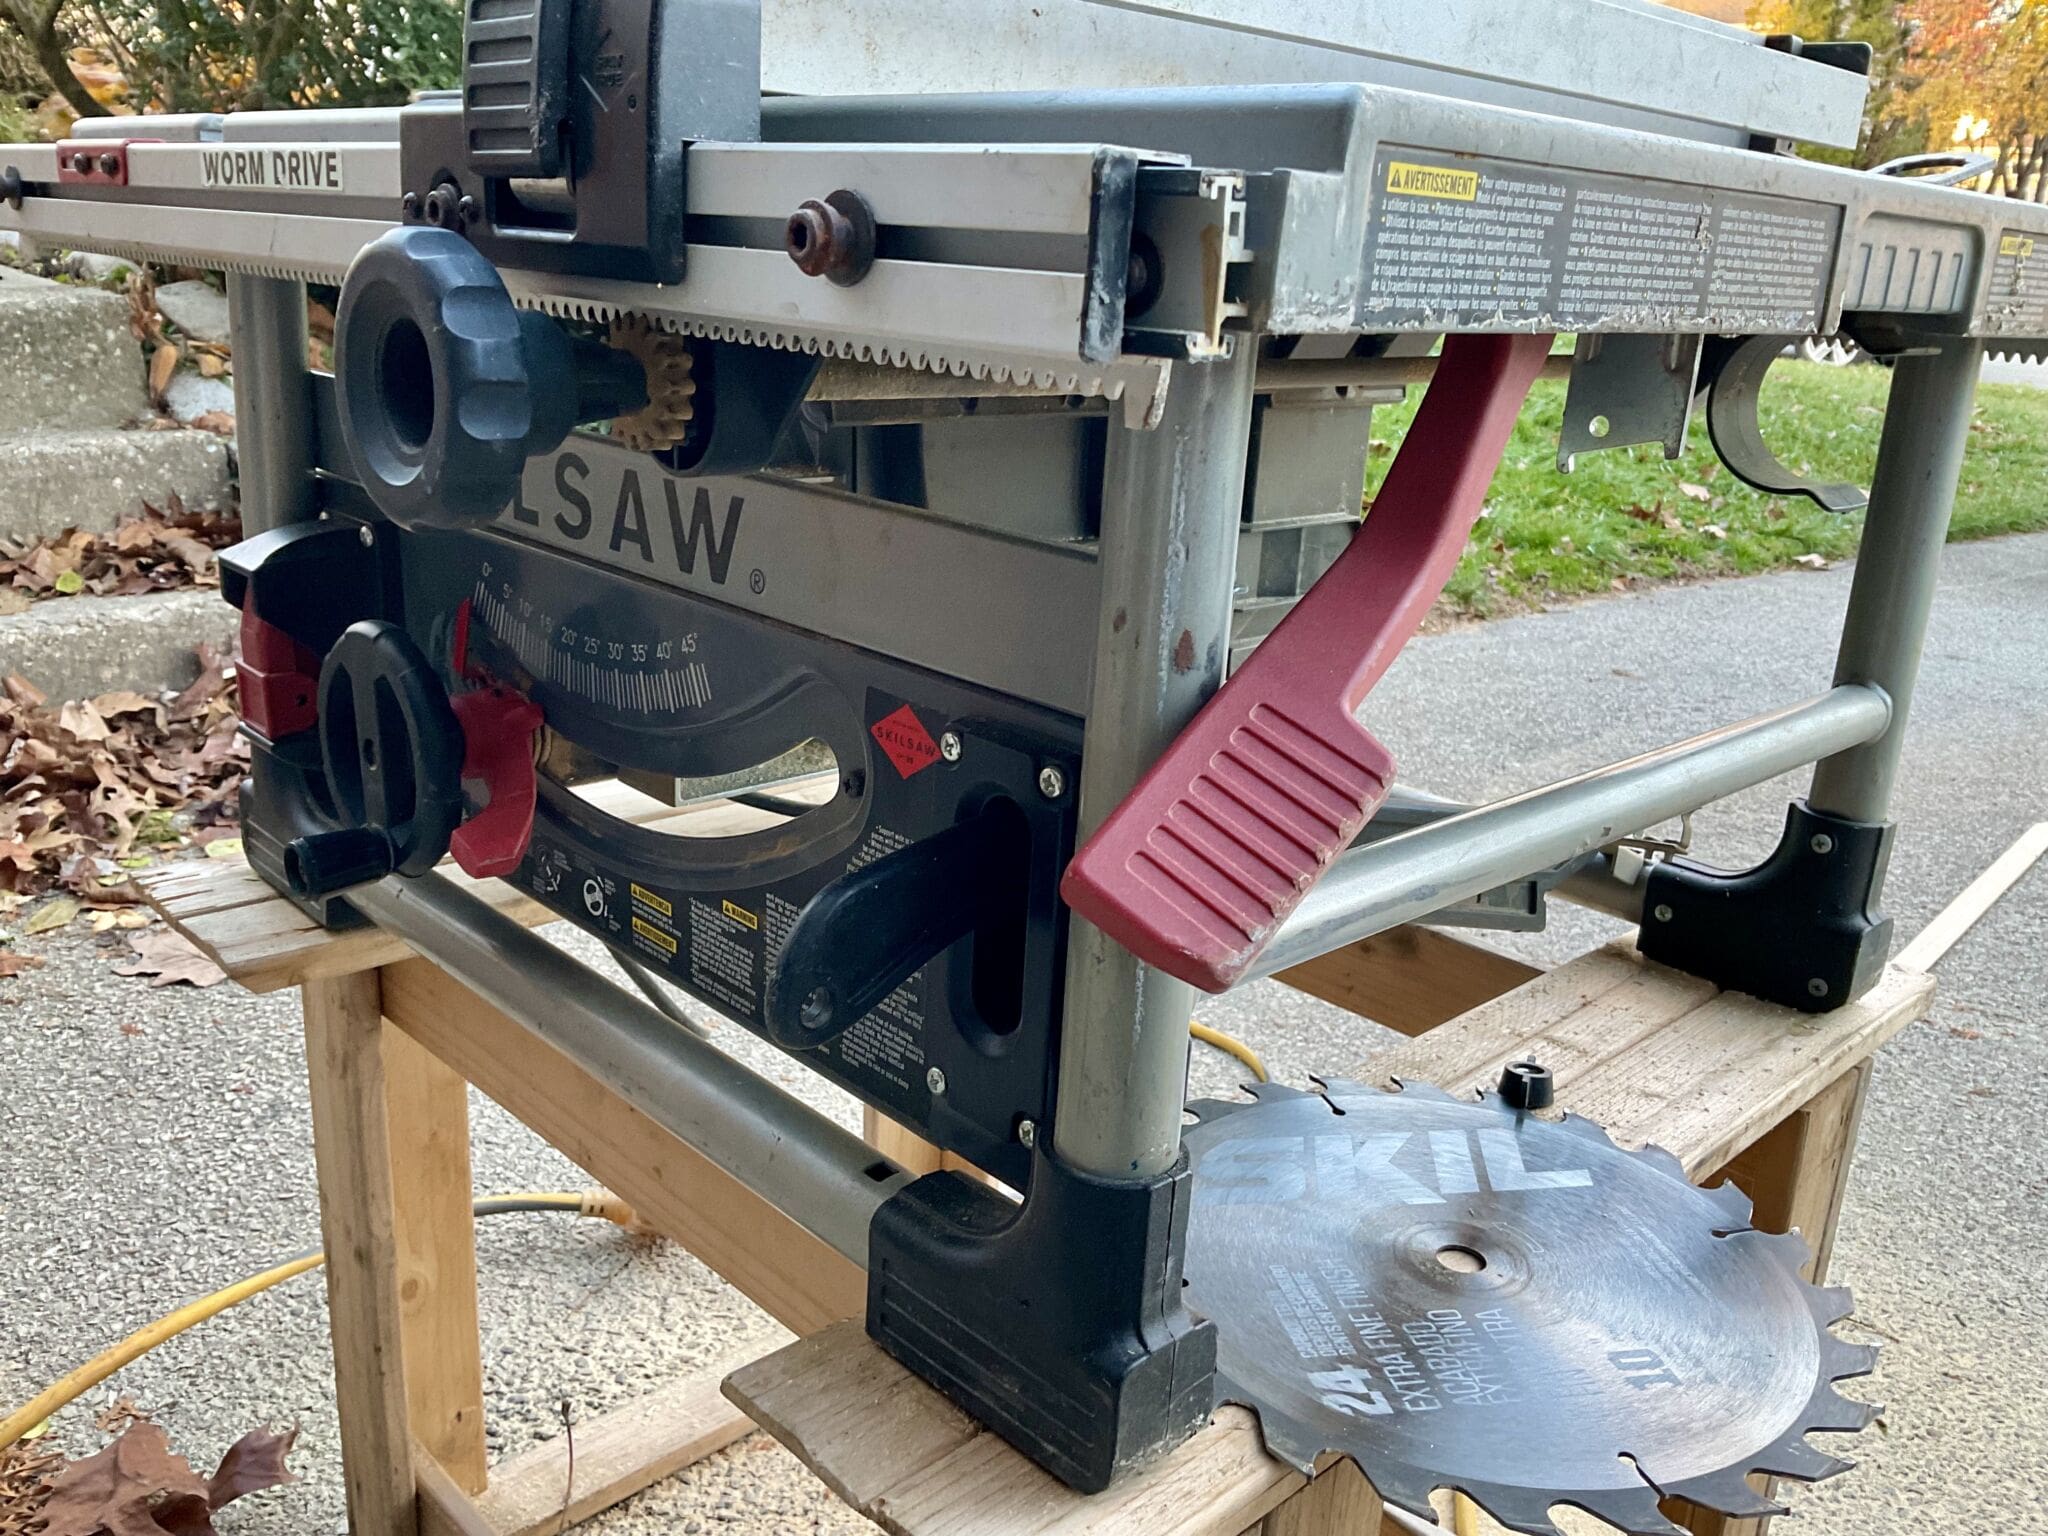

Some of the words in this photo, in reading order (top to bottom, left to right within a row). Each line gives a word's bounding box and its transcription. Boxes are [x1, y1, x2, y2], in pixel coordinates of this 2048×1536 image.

[202, 151, 265, 185] WORM
[273, 151, 339, 187] DRIVE
[1402, 168, 1473, 197] AVERTISSEMENT
[877, 726, 936, 757] SKILSAW
[731, 905, 756, 927] WARNING
[1196, 1128, 1594, 1207] SKIL
[1317, 1259, 1375, 1308] FINISH
[1348, 1312, 1402, 1350] FINE
[1376, 1351, 1443, 1412] EXTRA
[1402, 1321, 1482, 1404] ACABADO
[1306, 1363, 1394, 1417] 24
